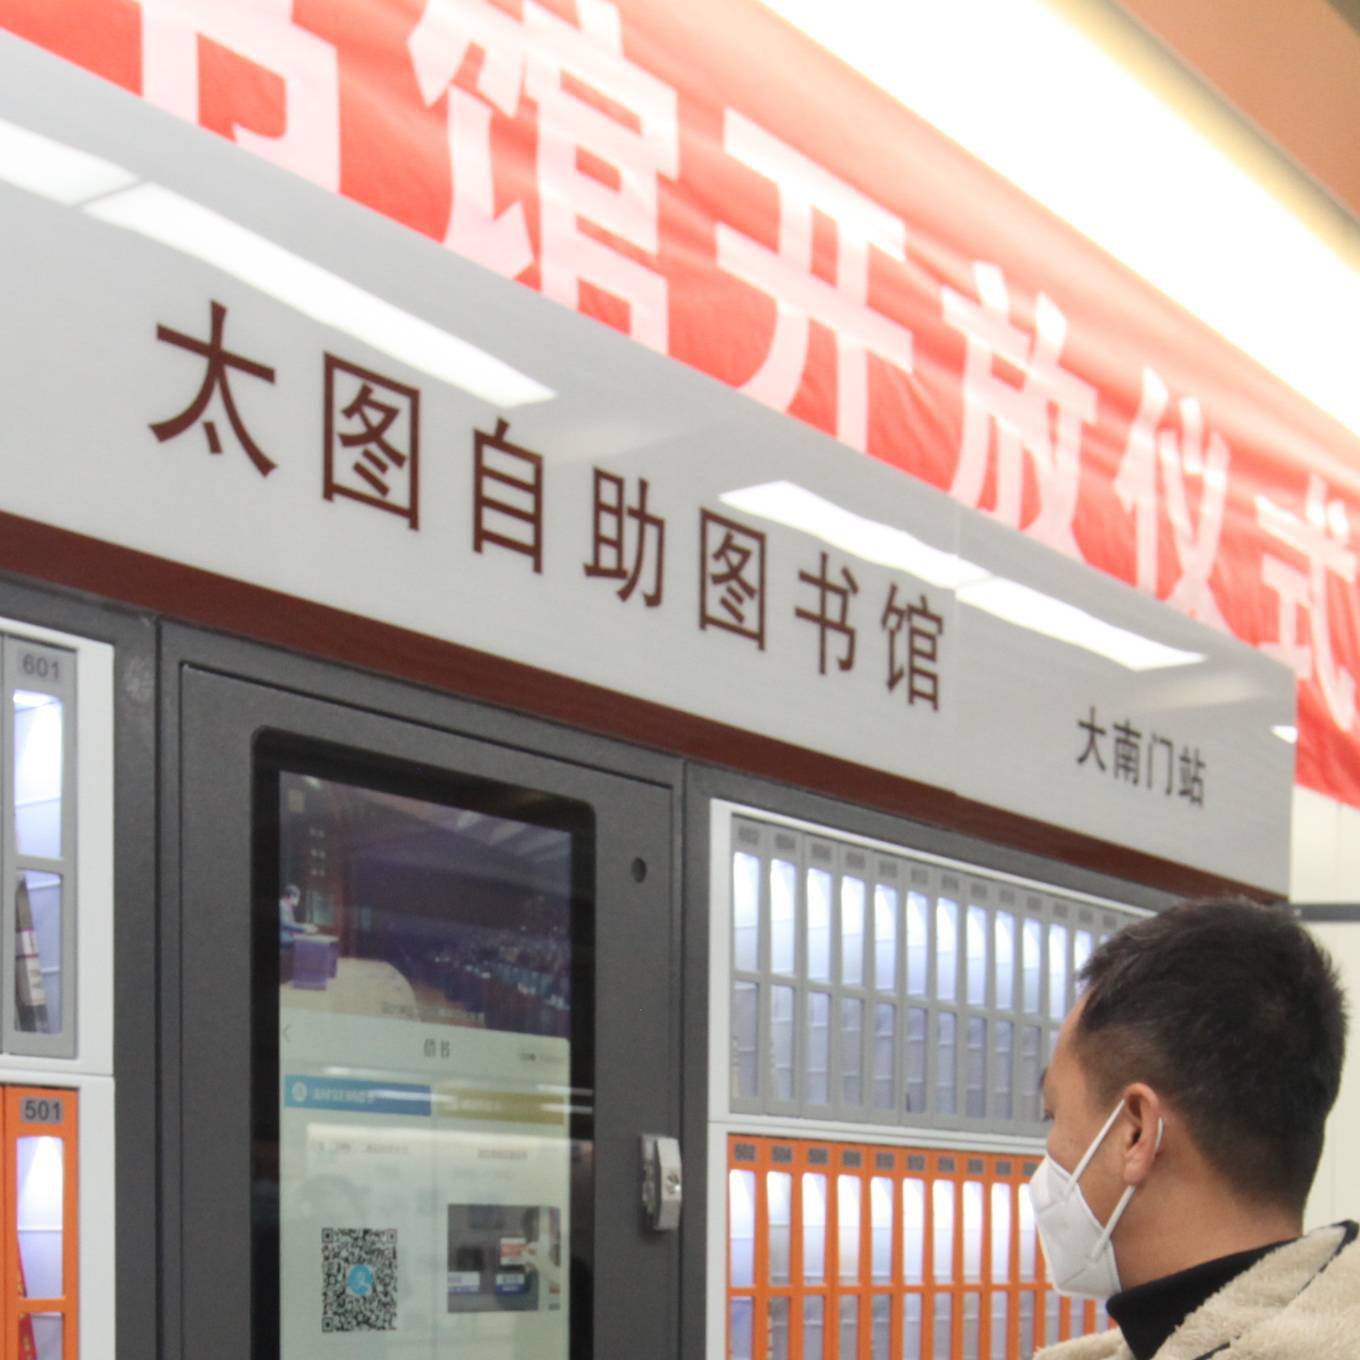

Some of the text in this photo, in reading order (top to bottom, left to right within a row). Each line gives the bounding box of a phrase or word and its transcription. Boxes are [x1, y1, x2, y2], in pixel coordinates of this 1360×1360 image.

[148, 299, 946, 713] 太图自助图书馆
[22, 653, 60, 680] 601
[1076, 705, 1206, 808] 大南门站
[24, 1100, 61, 1122] 501
